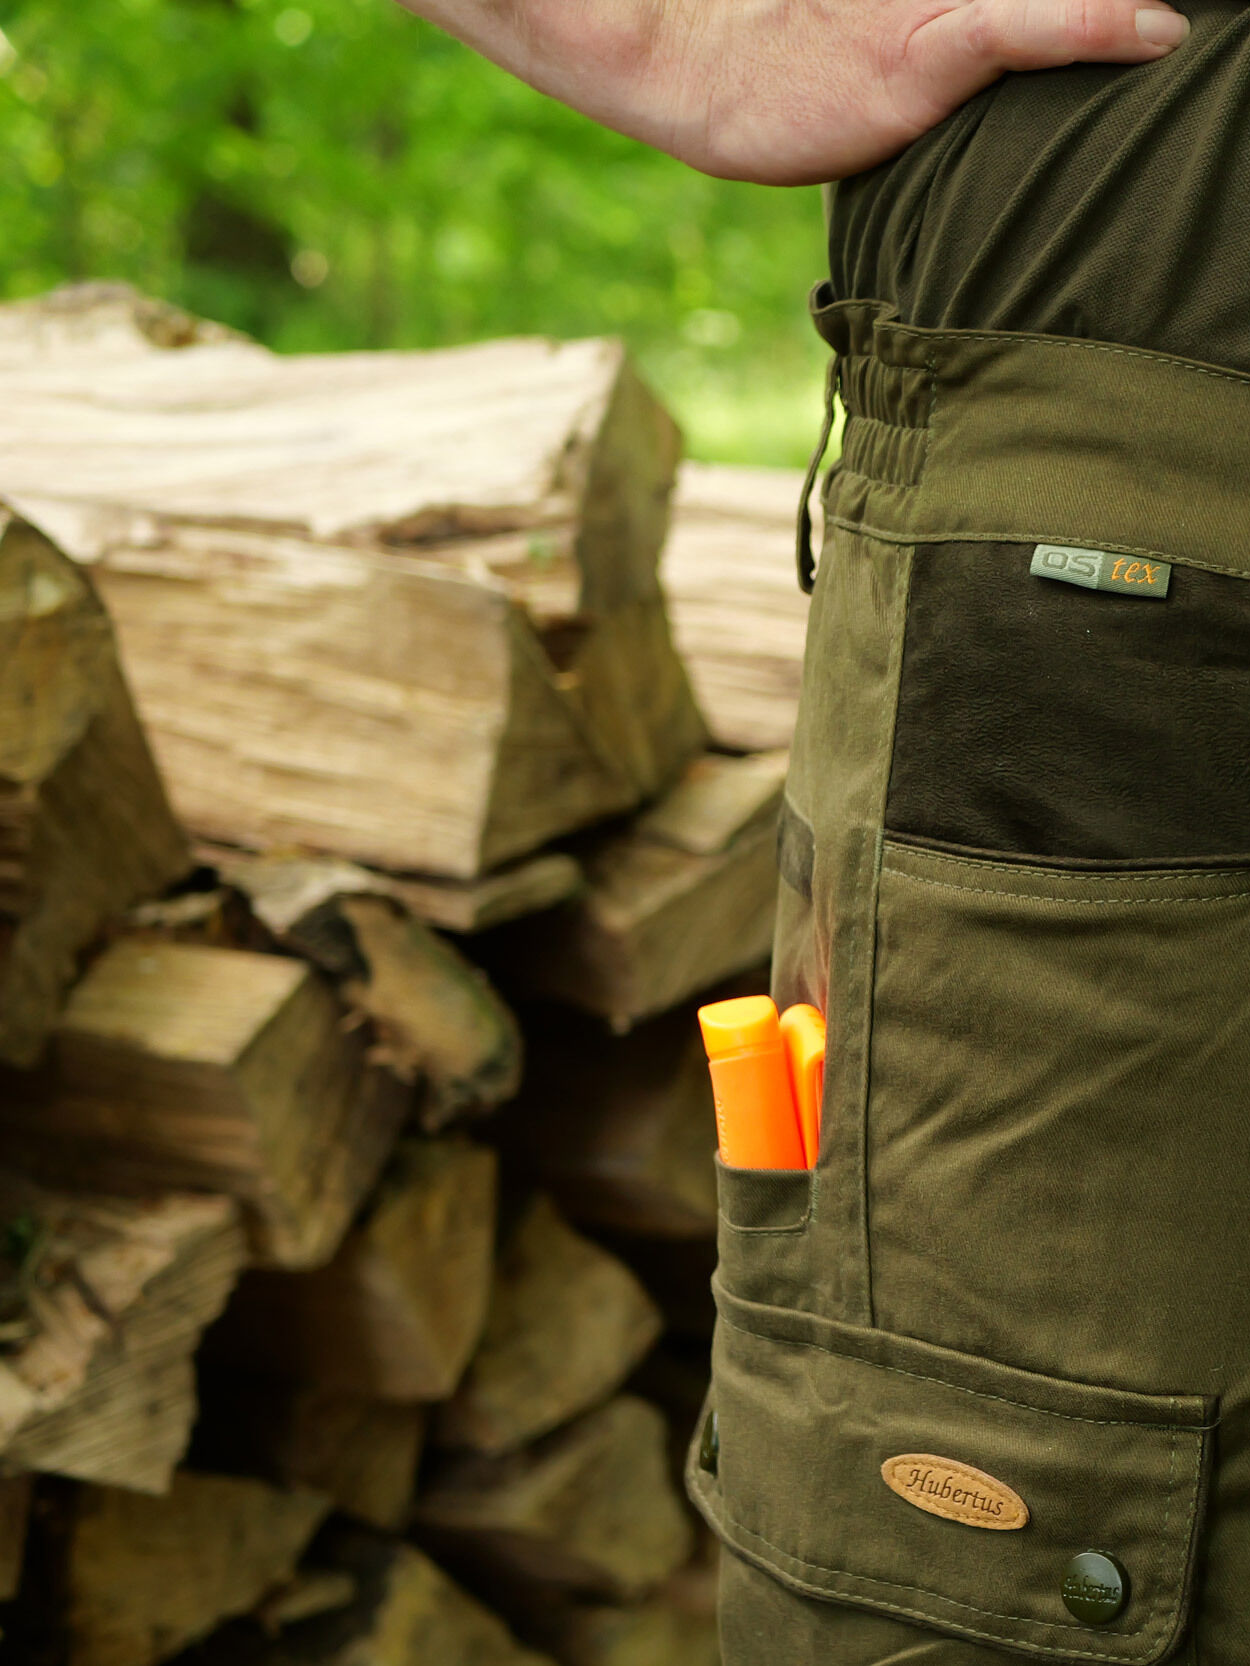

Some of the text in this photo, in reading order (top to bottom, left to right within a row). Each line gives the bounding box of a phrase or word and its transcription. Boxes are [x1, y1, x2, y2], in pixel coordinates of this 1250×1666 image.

[1042, 551, 1161, 585] OS tex
[906, 1469, 1004, 1517] Hubertus
